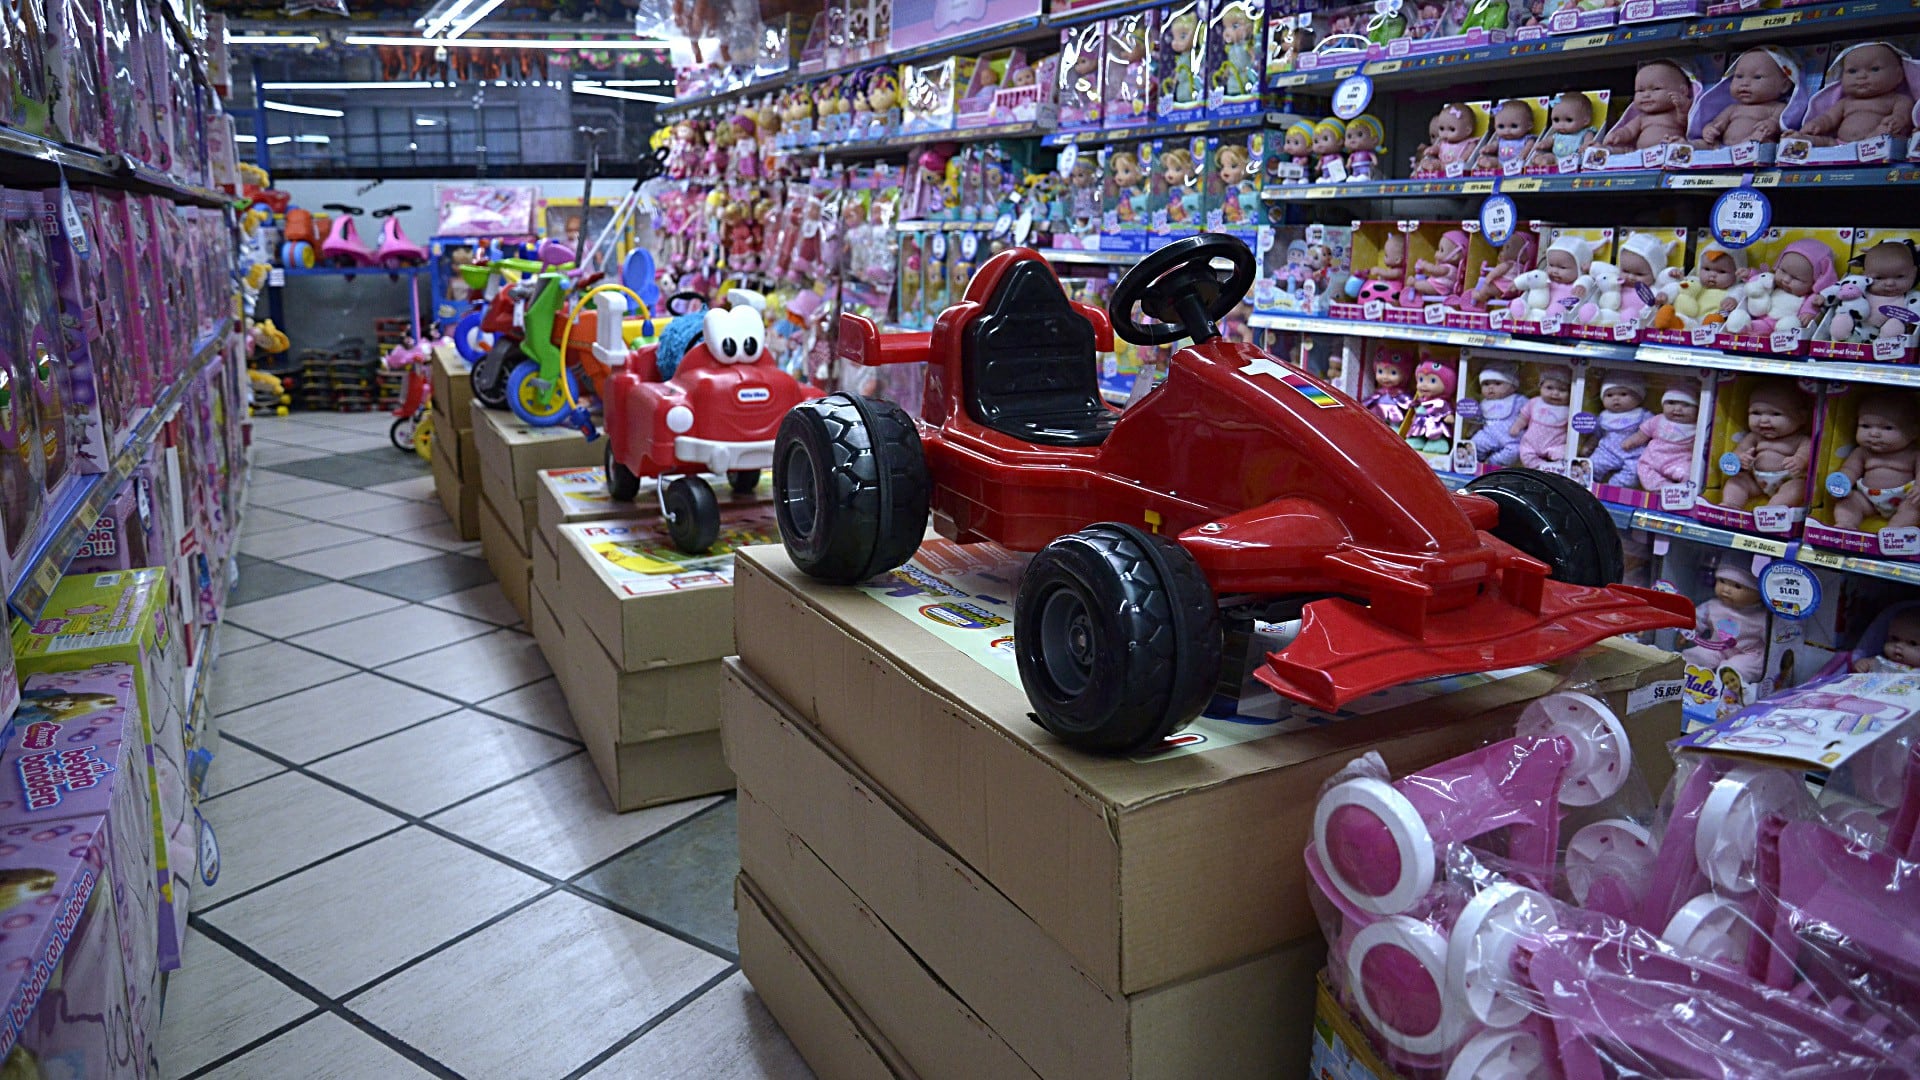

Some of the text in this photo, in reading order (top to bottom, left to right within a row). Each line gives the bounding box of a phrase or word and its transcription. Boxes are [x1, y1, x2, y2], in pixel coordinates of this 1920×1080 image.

[1821, 535, 1843, 544] design
[12, 965, 48, 1028] bebota
[46, 936, 63, 967] con
